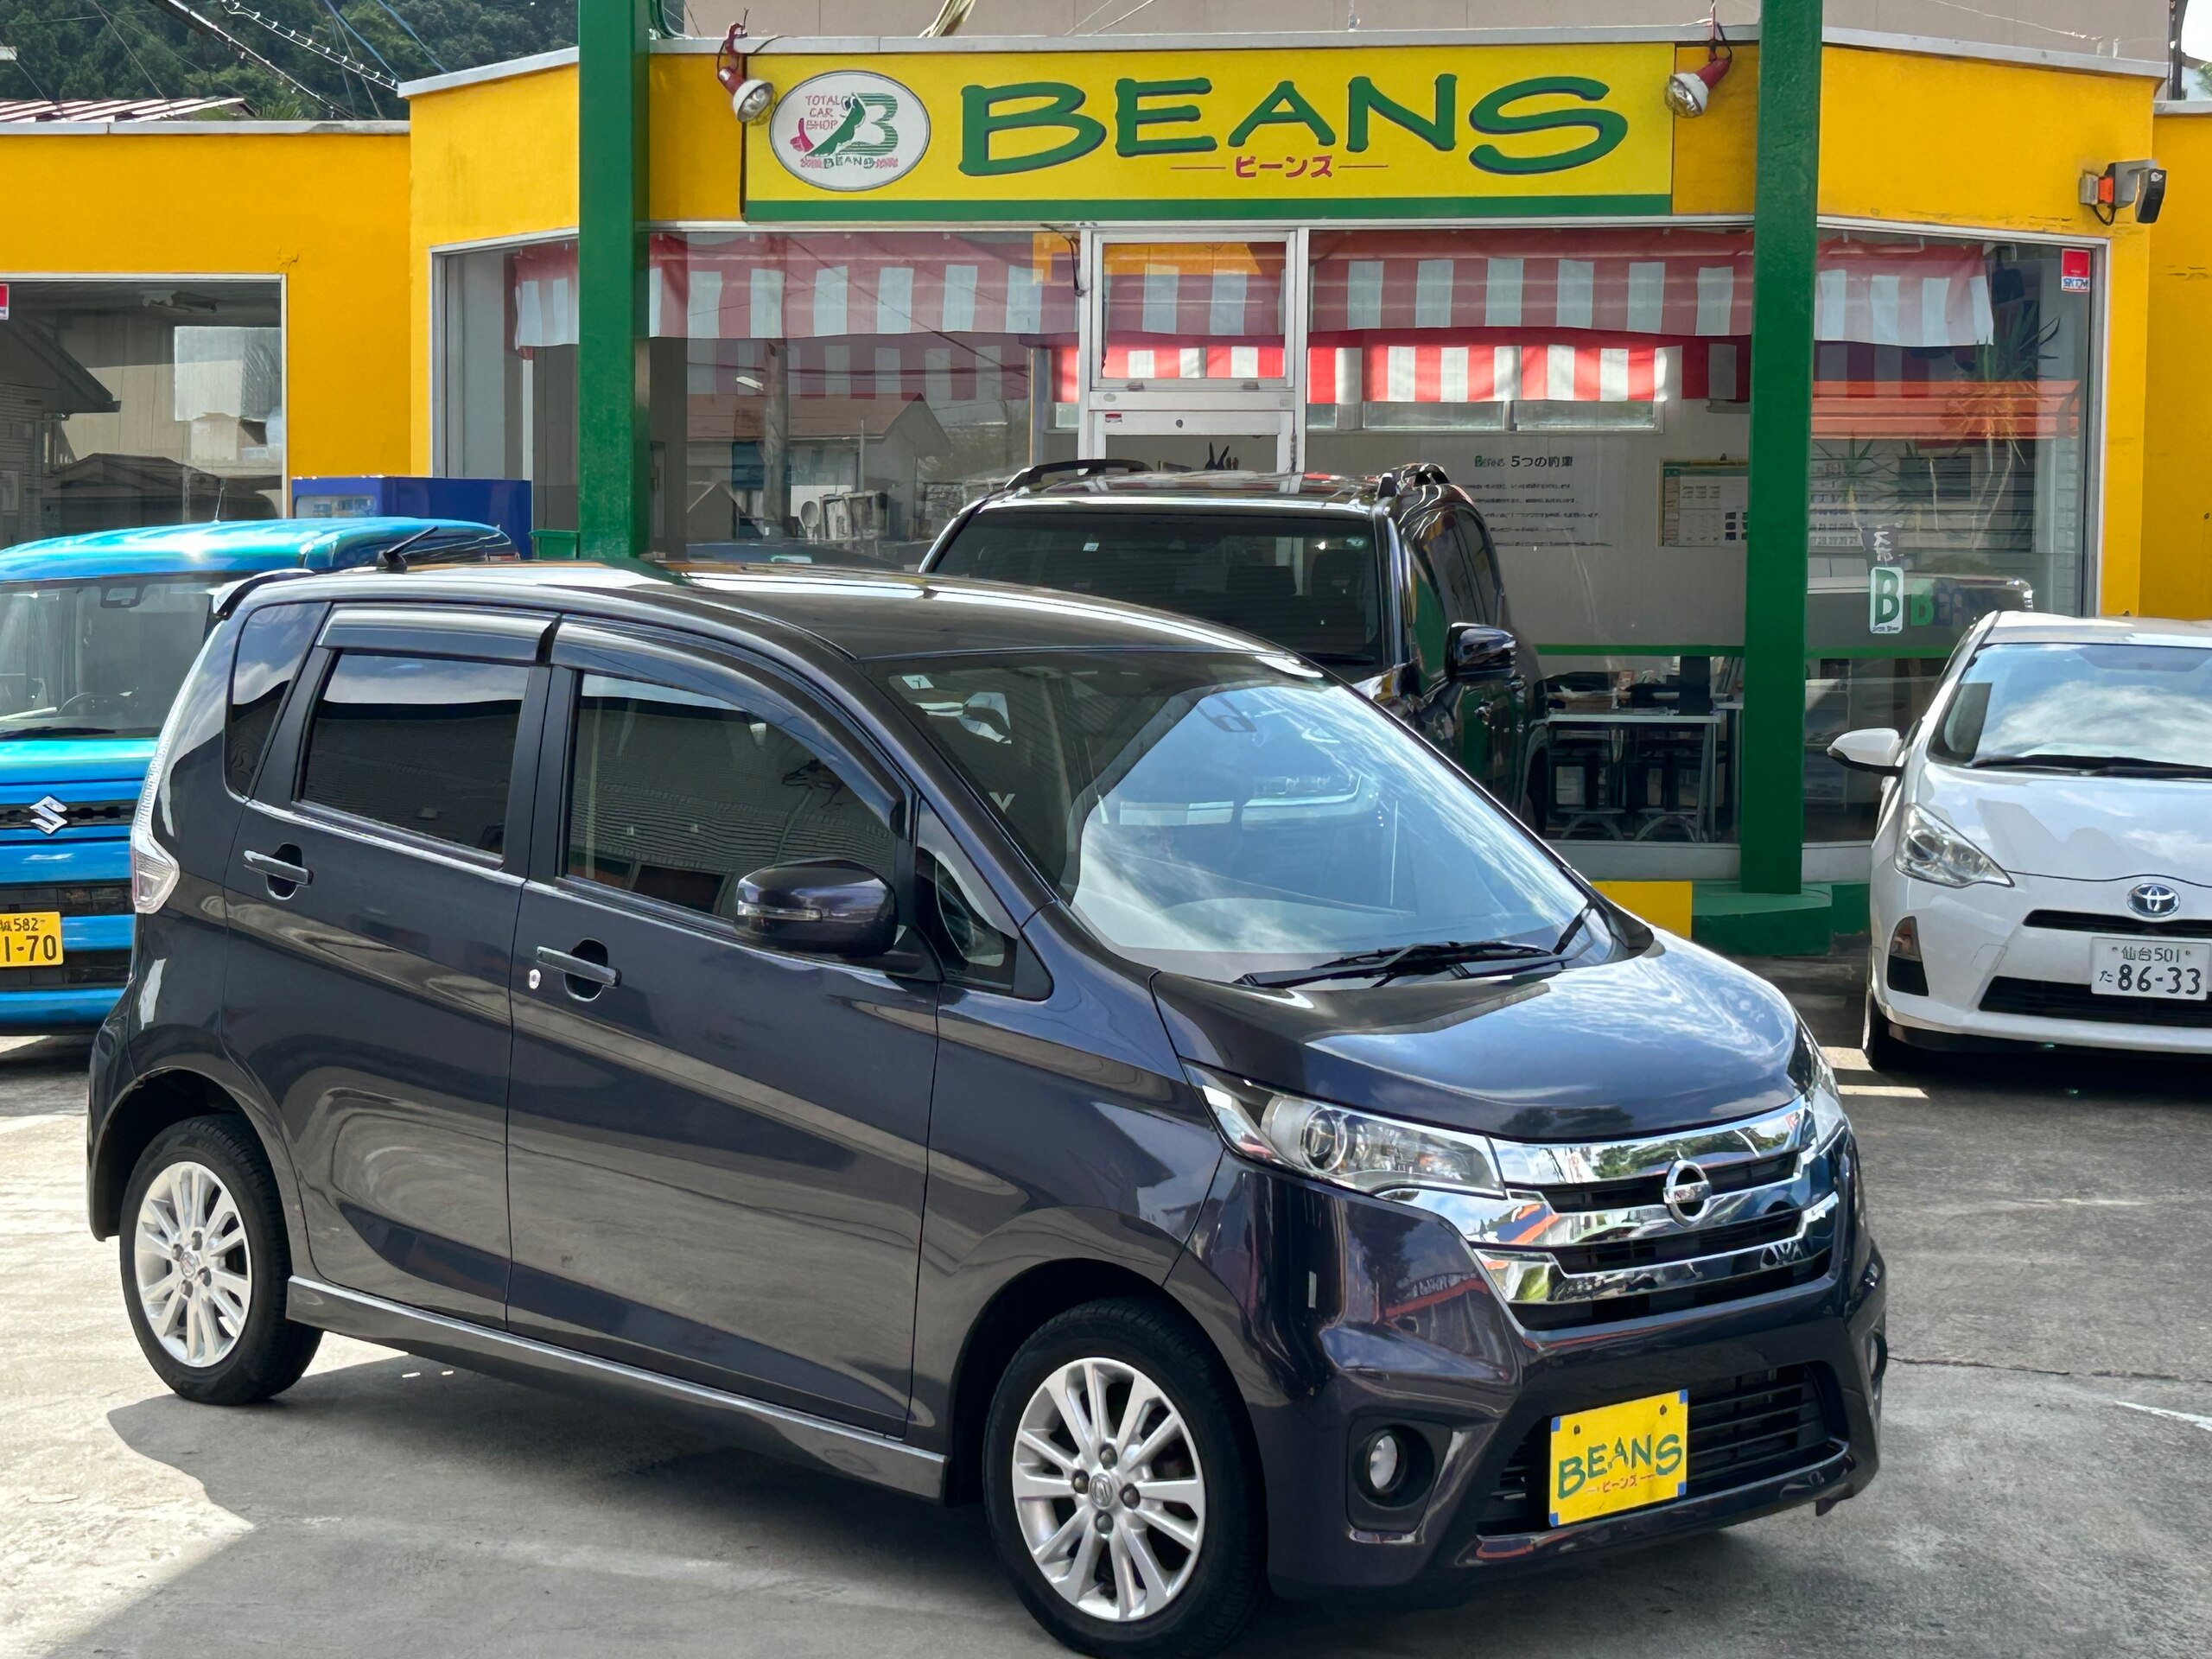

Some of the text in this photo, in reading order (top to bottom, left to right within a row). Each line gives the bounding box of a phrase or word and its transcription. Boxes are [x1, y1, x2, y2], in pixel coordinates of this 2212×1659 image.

[805, 95, 840, 106] TOTAL
[809, 107, 834, 118] CAR
[805, 119, 838, 130] SHOP
[959, 73, 1628, 175] BEANS
[823, 156, 875, 168] BEANS
[1236, 156, 1332, 178] ビーンズ
[1874, 569, 1899, 626] B
[2099, 963, 2202, 995] た 86-33
[1557, 1433, 1682, 1499] BEANS
